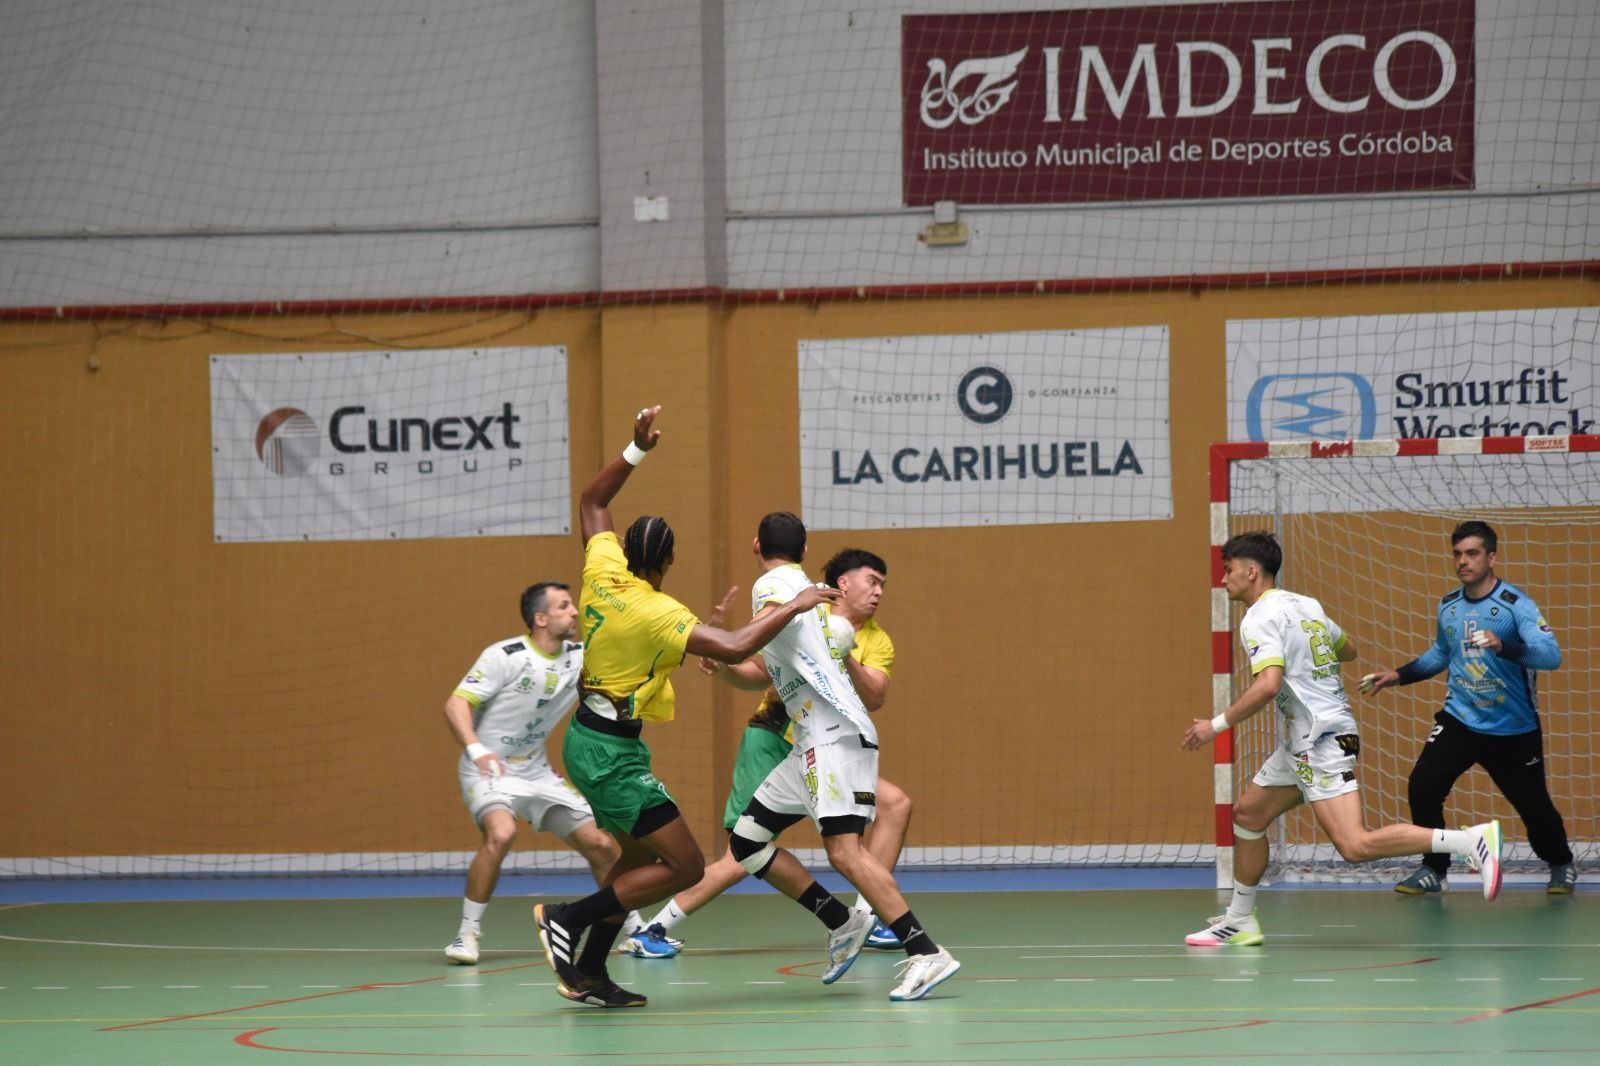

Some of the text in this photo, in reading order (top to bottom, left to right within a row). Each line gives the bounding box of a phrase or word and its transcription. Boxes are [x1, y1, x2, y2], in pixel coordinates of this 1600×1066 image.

[1042, 30, 1457, 124] IMDECO
[923, 130, 1453, 171] Instituto Municipal de Deportes Córdoba
[1395, 367, 1569, 409] Smurfit
[328, 402, 521, 454] Cunext
[329, 458, 523, 477] GROUP
[832, 440, 1144, 485] LA CARIHUELA
[585, 604, 605, 650] 7
